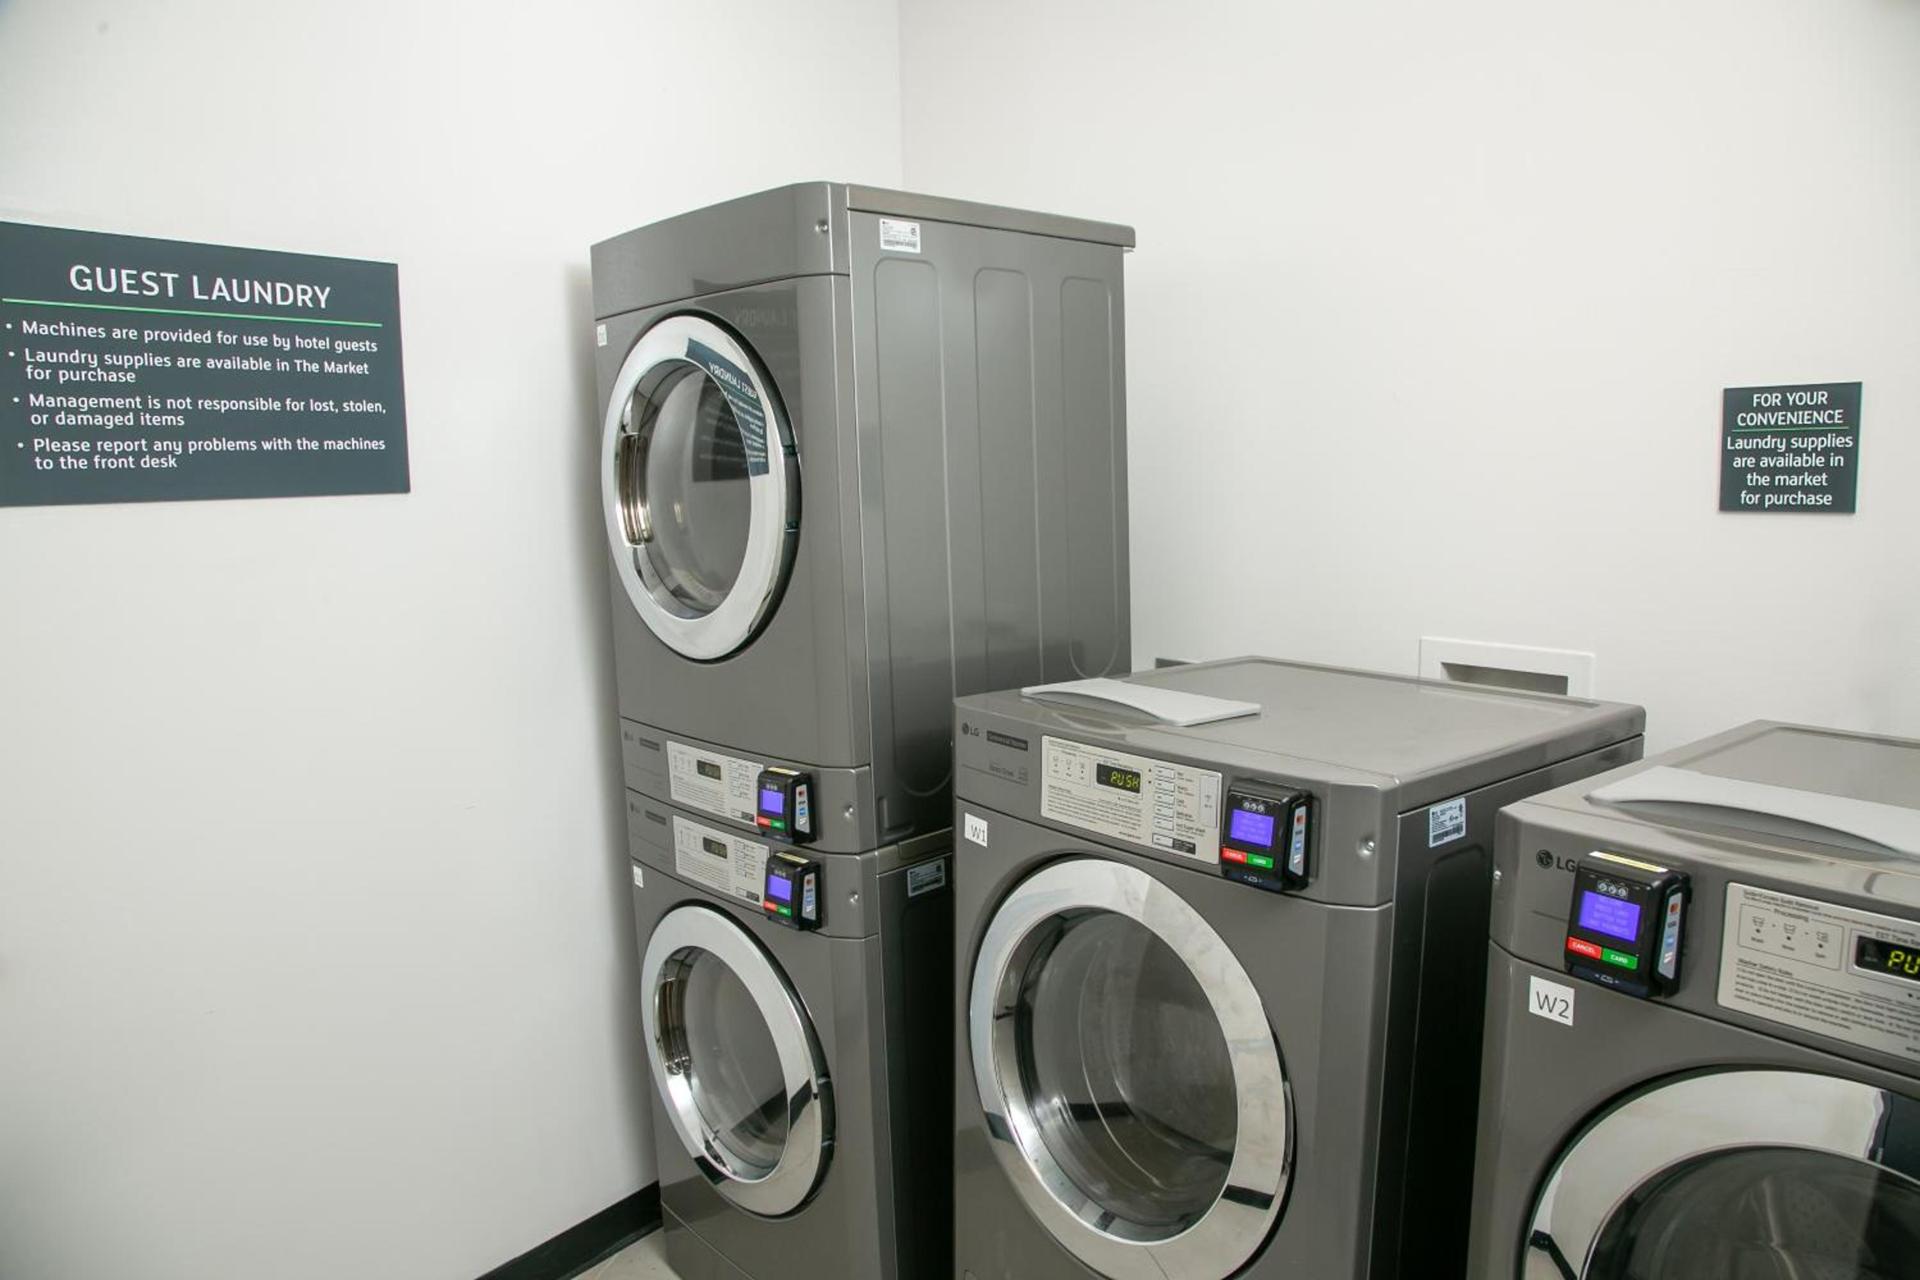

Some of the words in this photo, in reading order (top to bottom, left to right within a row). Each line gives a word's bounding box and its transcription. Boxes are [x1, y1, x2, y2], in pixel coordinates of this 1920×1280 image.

[69, 264, 179, 298] GUEST
[192, 275, 331, 309] LAUNDRY
[22, 320, 106, 338] Machines
[112, 327, 138, 340] are
[144, 329, 212, 344] provided
[216, 331, 238, 345] for
[243, 335, 268, 346] use
[273, 333, 291, 351] by
[295, 335, 330, 350] hotel
[335, 340, 378, 354] guests
[25, 348, 98, 368] Laundry
[104, 352, 172, 369] supplies
[177, 356, 201, 369] are
[206, 357, 272, 371] available
[276, 358, 290, 372] in
[294, 359, 320, 373] The
[324, 361, 369, 375] Market
[25, 365, 52, 380] for
[59, 368, 136, 384] purchase
[29, 393, 142, 411] Management
[148, 395, 161, 409] is
[166, 397, 192, 409] not
[198, 398, 281, 413] responsible
[285, 398, 305, 411] for
[310, 399, 339, 413] lost,
[343, 400, 386, 414] stolen,
[1753, 392, 1782, 407] FOR
[1787, 391, 1828, 406] YOUR
[31, 413, 49, 425] or
[55, 411, 134, 429] damaged
[140, 412, 185, 426] items
[1737, 409, 1844, 426] CONVENIENCE
[34, 438, 90, 452] Please
[96, 438, 147, 454] report
[153, 440, 182, 455] any
[188, 438, 257, 454] problems
[261, 437, 292, 450] with
[297, 437, 319, 450] the
[324, 437, 386, 450] machines
[1727, 435, 1786, 452] Laundry
[1791, 433, 1853, 451] supplies
[34, 456, 53, 469] to
[60, 455, 88, 469] the
[93, 455, 135, 469] front
[140, 455, 178, 468] desk
[1733, 456, 1755, 468] are
[1760, 453, 1825, 467] available
[1830, 453, 1844, 467] in
[1746, 472, 1770, 486] the
[1775, 472, 1828, 486] market
[1740, 490, 1760, 505] for
[1765, 491, 1832, 508] purchase
[1110, 771, 1140, 789] PUSH
[970, 824, 986, 842] W1
[1556, 856, 1577, 873] LG
[1536, 990, 1570, 1020] W2
